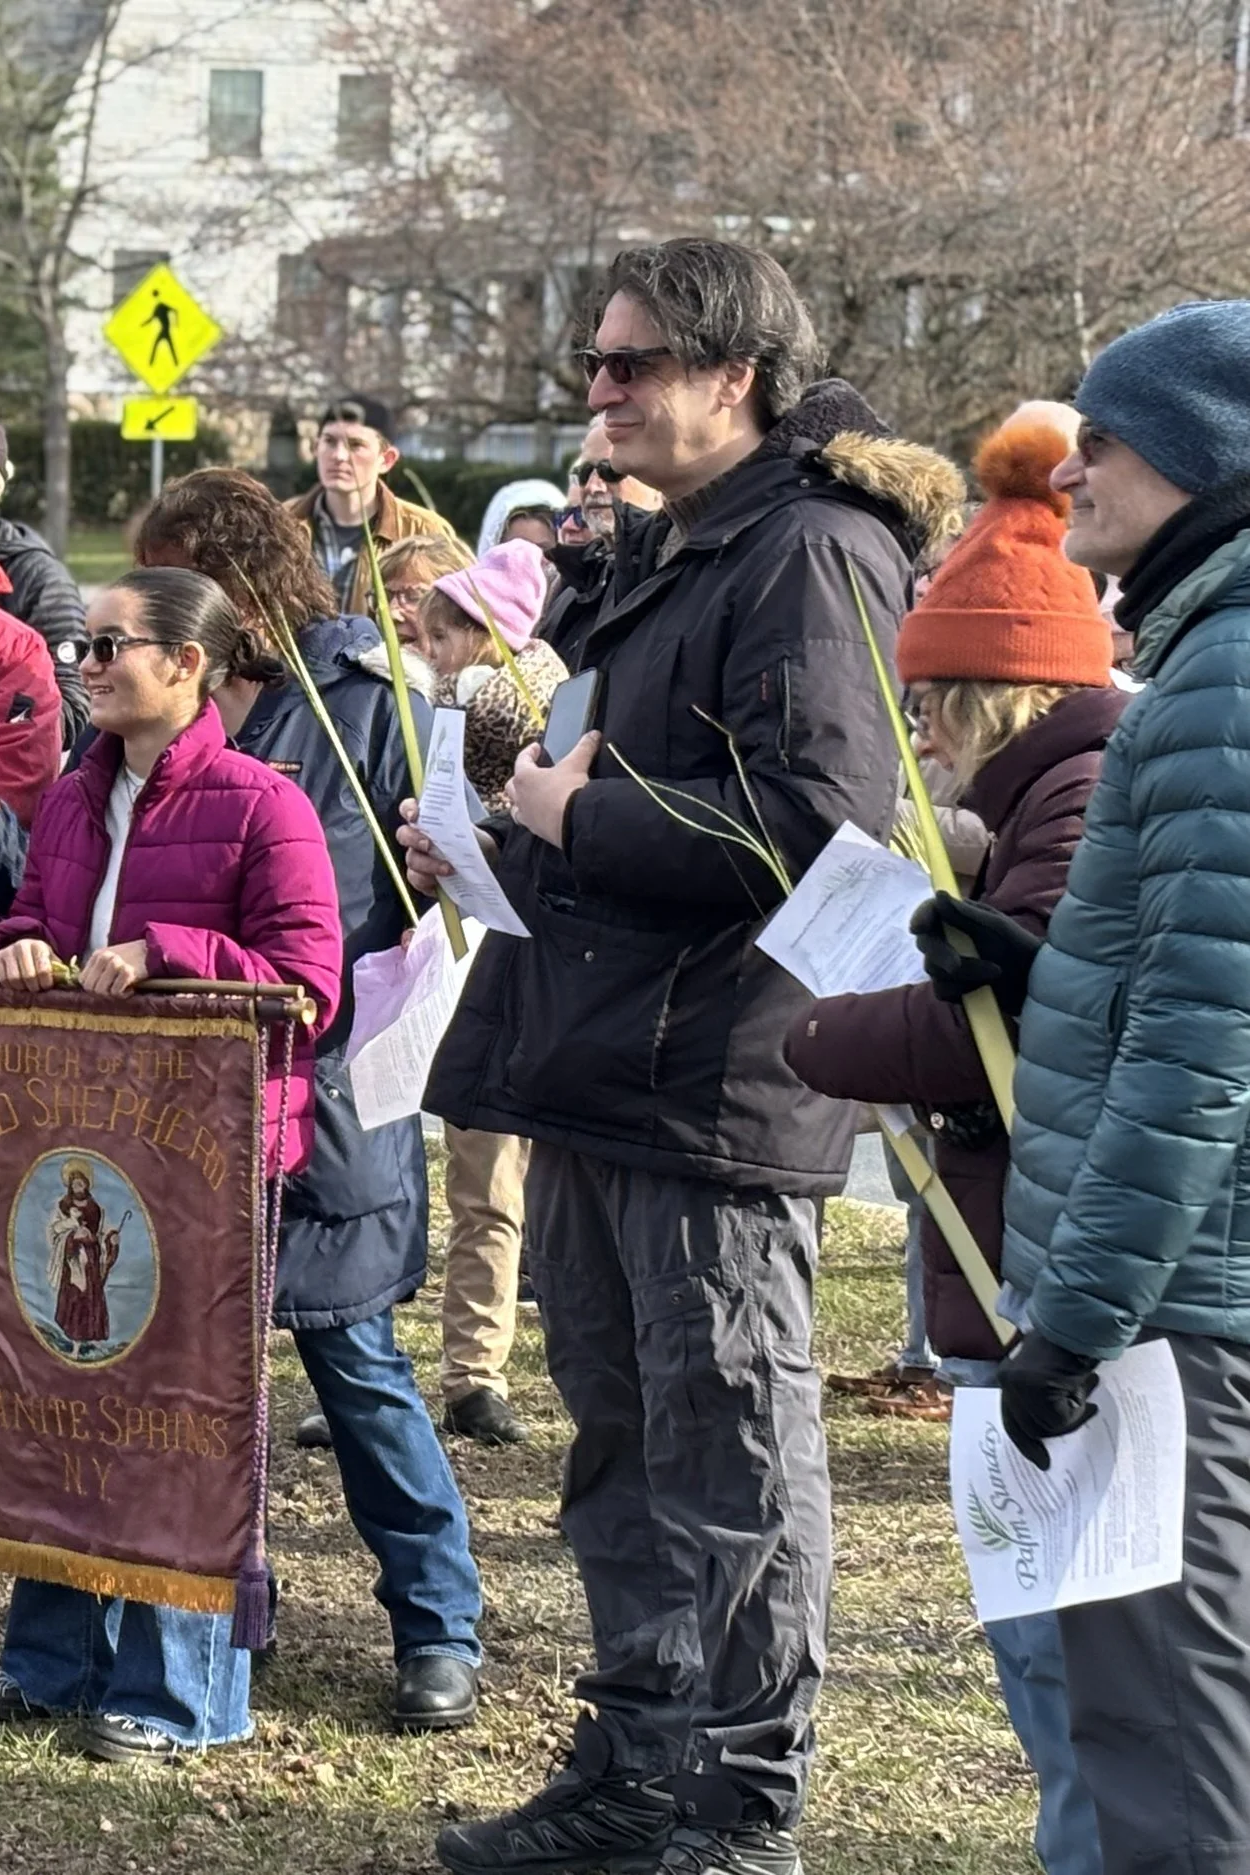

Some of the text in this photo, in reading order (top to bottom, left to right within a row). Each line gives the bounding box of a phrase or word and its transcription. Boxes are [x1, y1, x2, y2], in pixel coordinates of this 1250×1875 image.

[134, 1047, 194, 1081] THE
[99, 1394, 229, 1460] SPRINGS
[978, 1420, 1040, 1591] Palm Sunday
